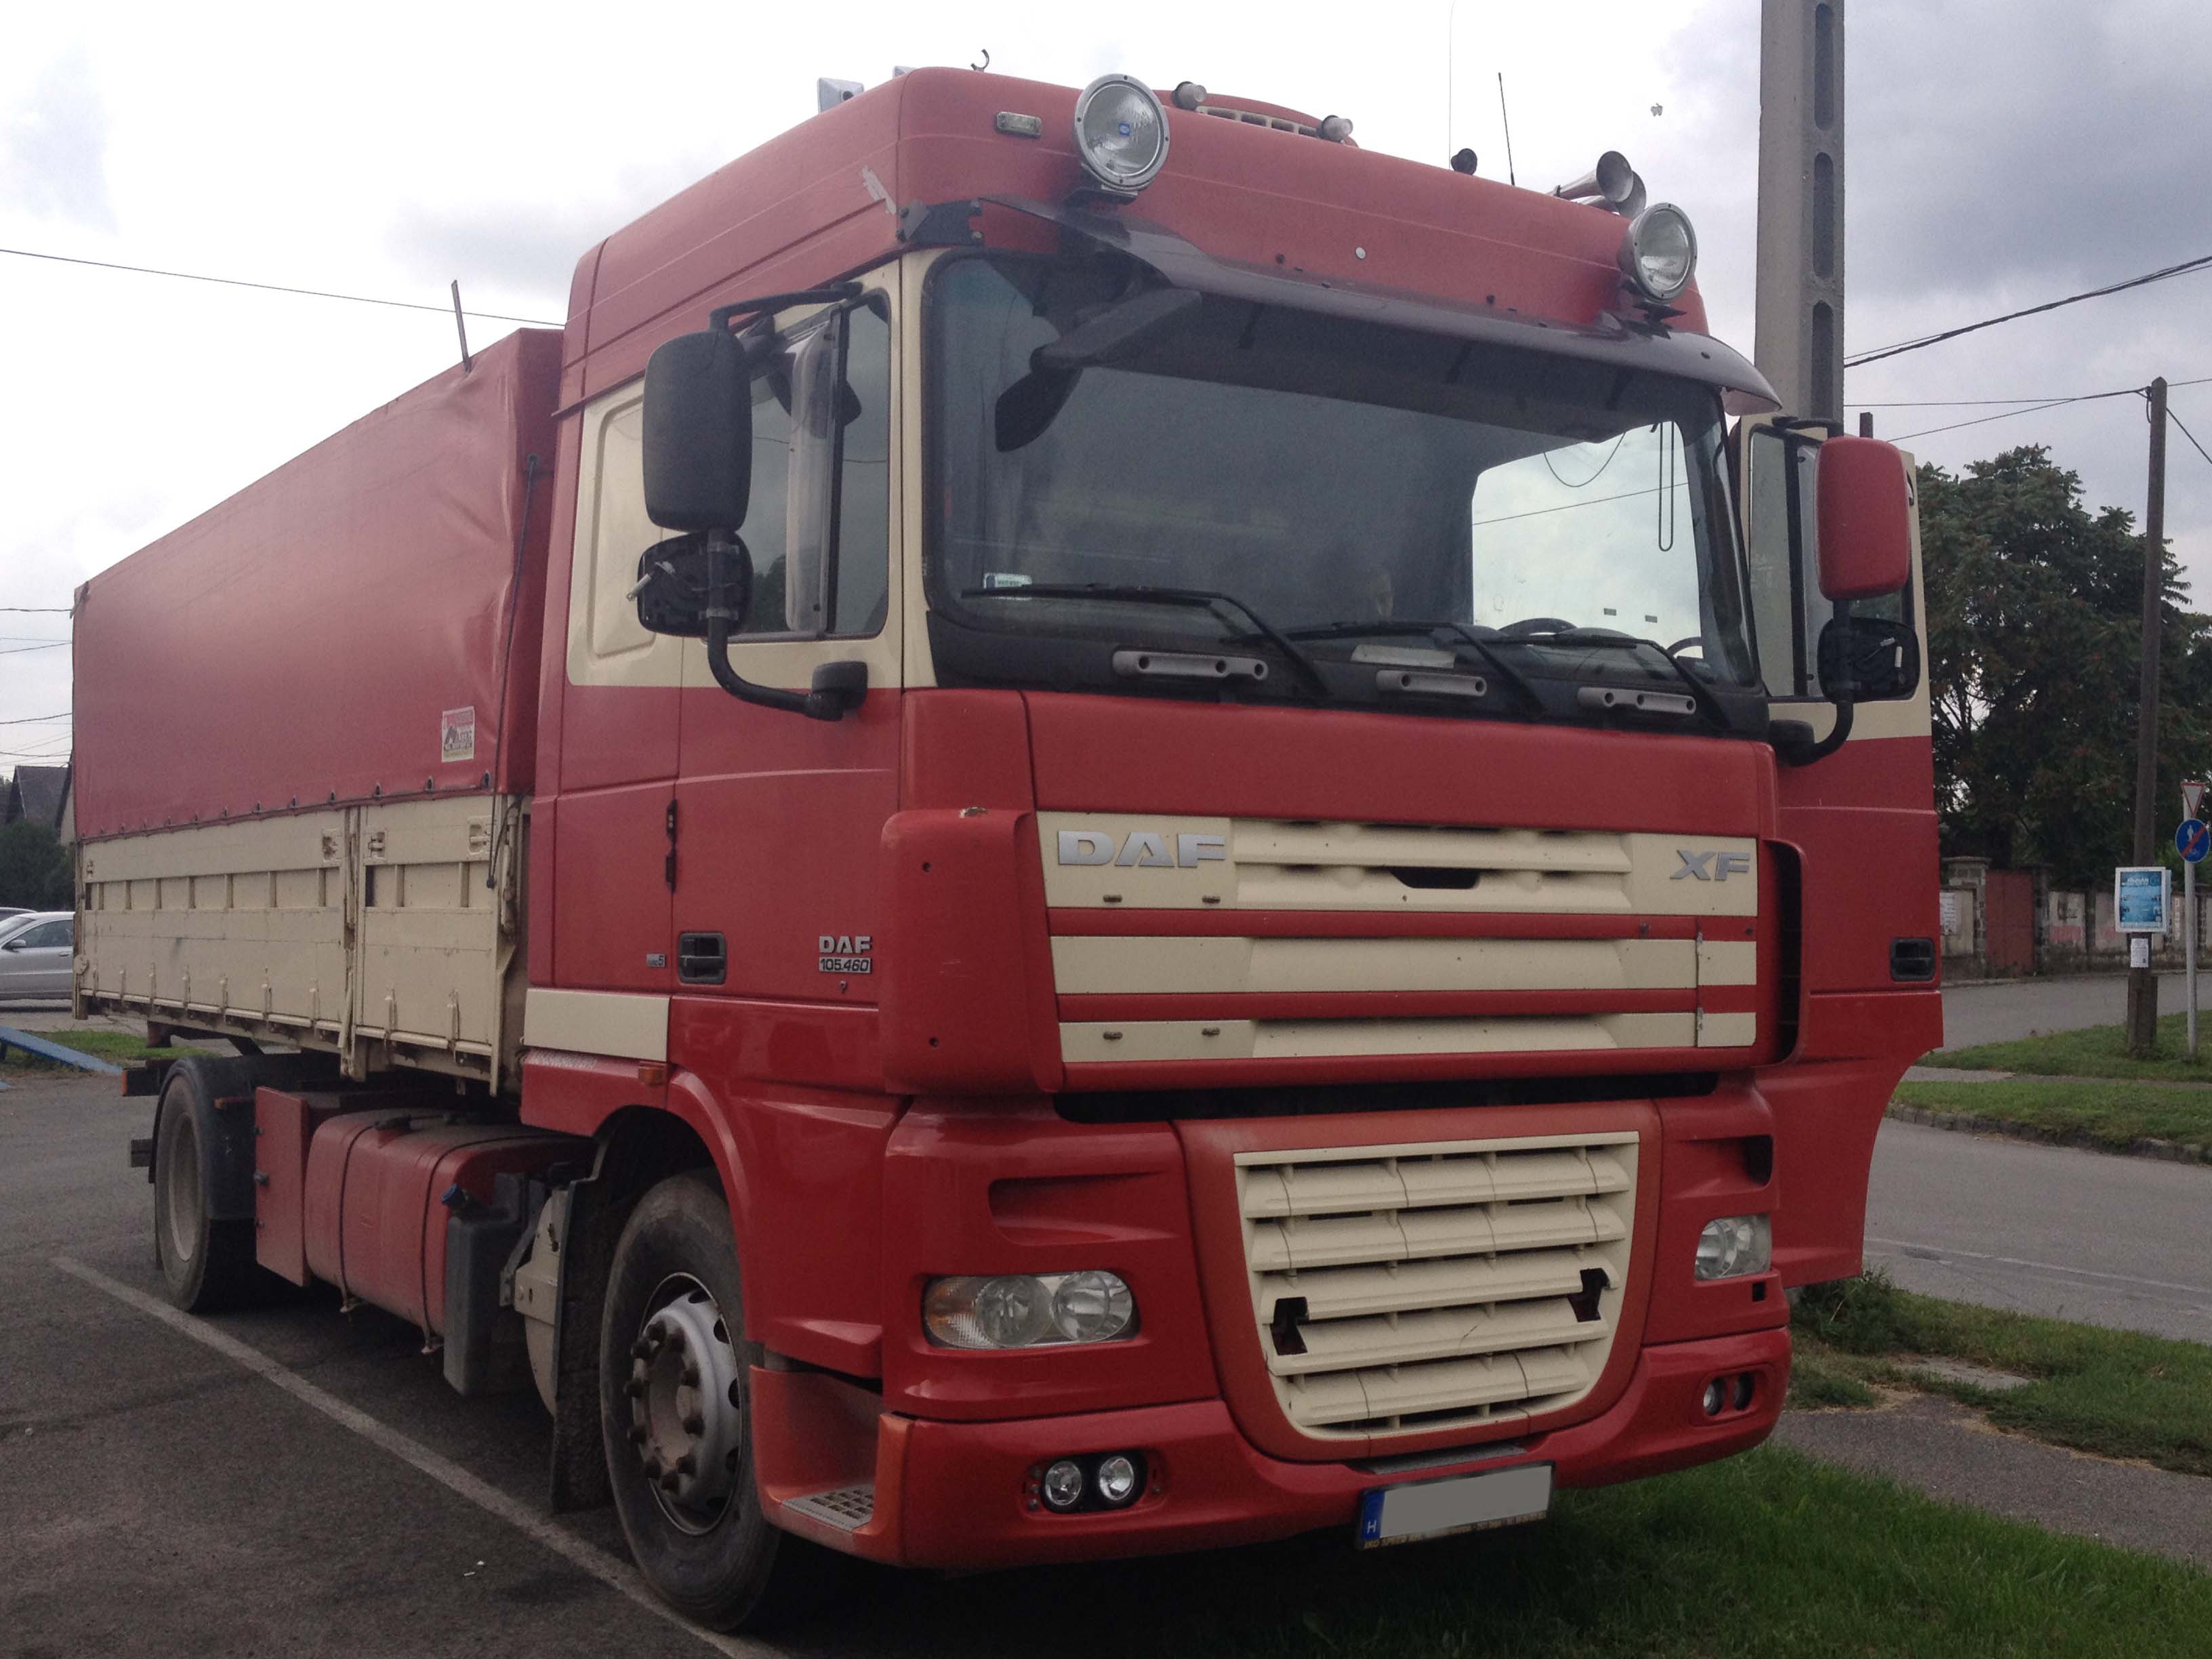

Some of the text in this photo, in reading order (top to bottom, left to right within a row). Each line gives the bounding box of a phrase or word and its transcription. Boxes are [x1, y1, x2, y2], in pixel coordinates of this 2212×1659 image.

[1057, 830, 1225, 869] DAF
[1670, 850, 1750, 881] XF
[819, 935, 871, 954] DAF
[820, 958, 869, 972] 105.460
[1366, 1519, 1377, 1534] H
